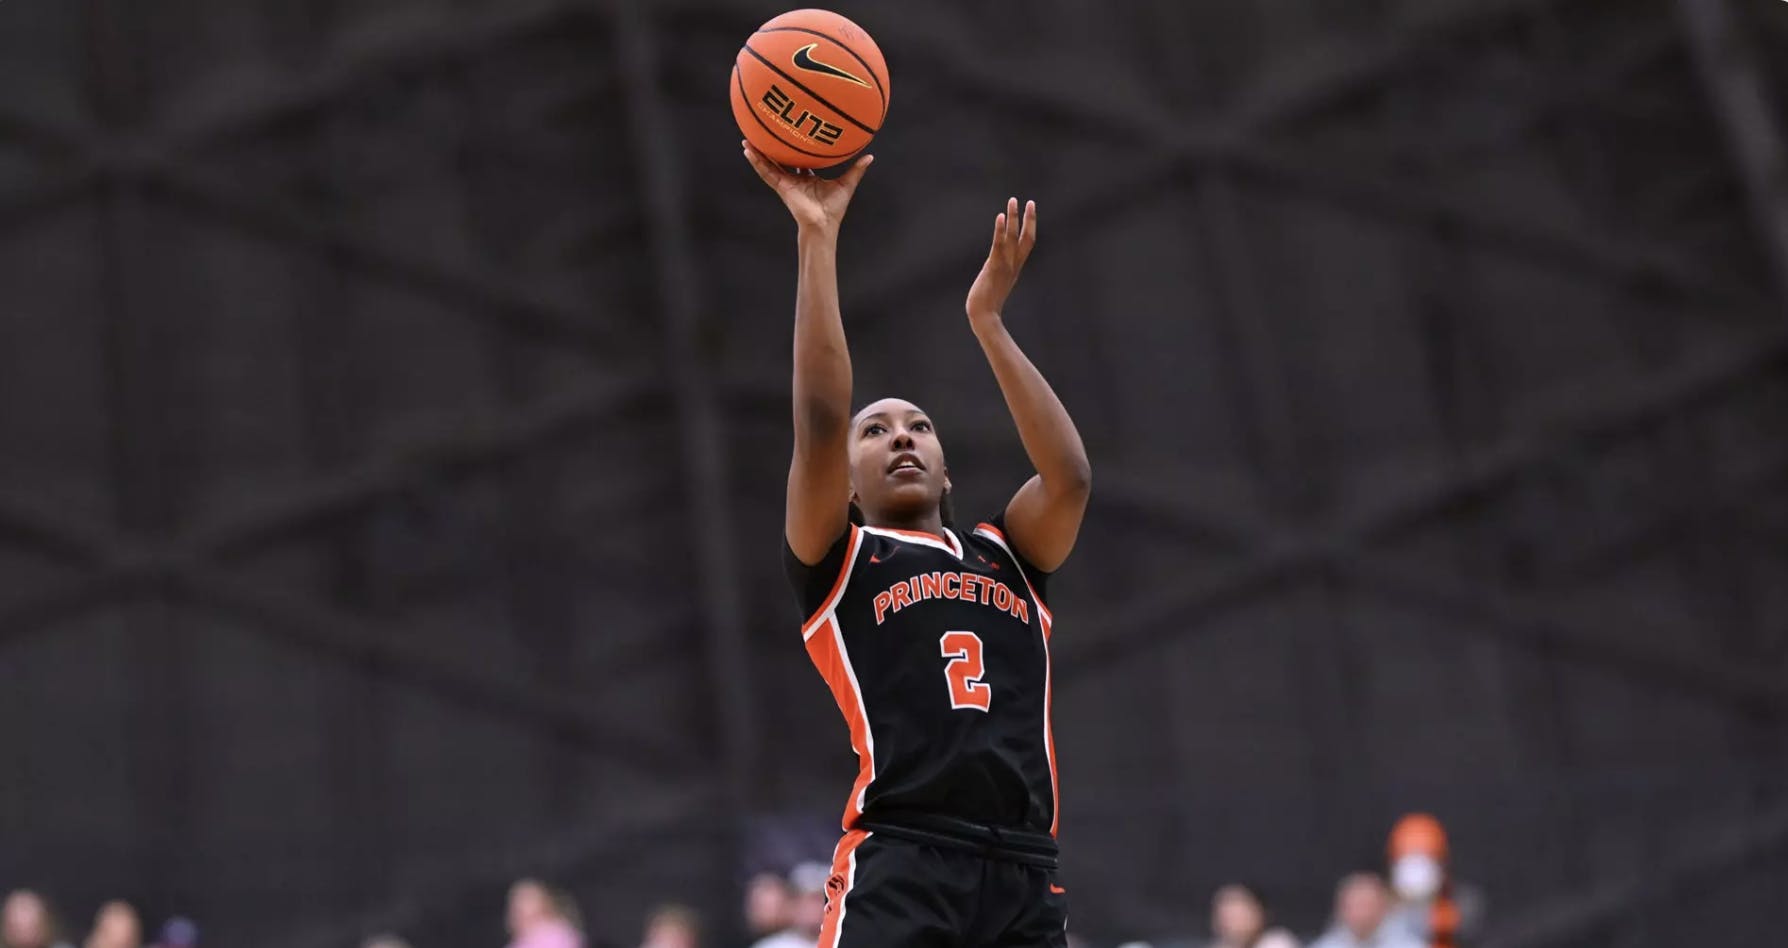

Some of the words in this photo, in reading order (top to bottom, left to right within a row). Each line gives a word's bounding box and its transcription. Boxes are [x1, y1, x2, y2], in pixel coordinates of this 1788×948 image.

[762, 84, 843, 146] ELITE
[873, 571, 1028, 625] PRINCETON
[939, 631, 991, 712] 2
